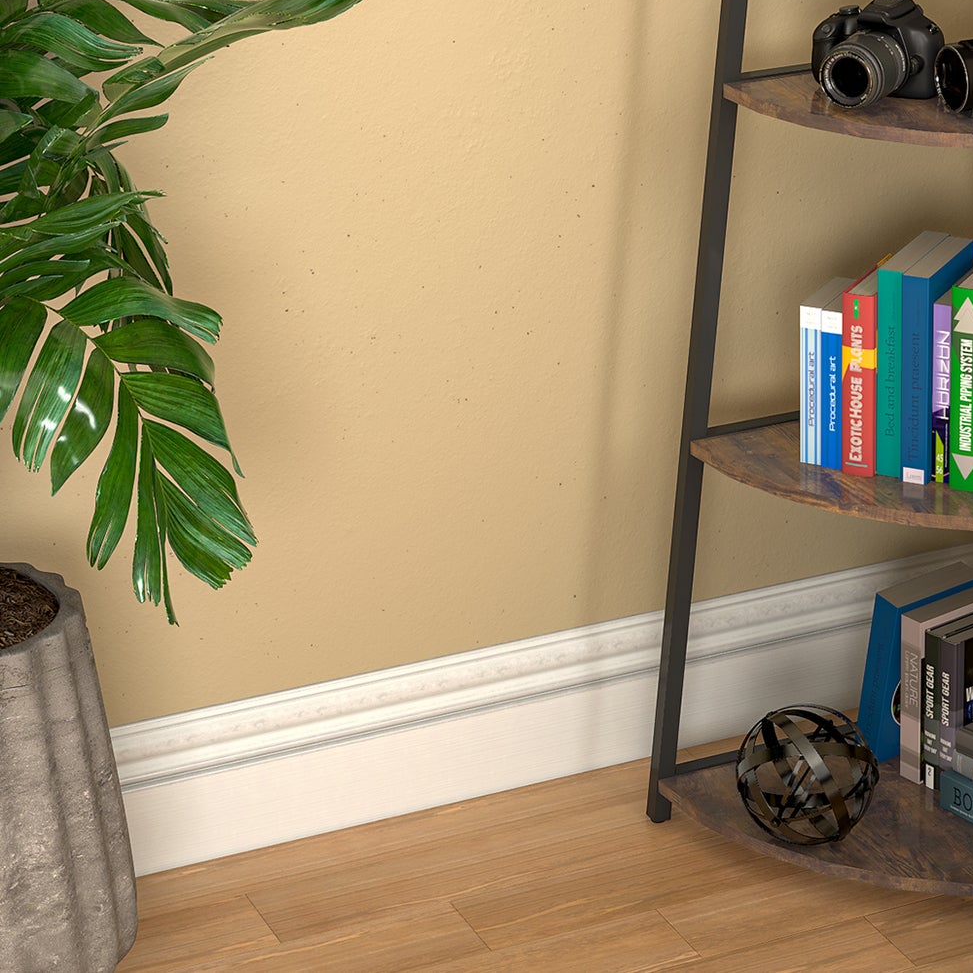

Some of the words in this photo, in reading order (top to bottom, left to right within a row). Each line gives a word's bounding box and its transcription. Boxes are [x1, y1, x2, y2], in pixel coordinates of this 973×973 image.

[829, 356, 837, 372] art
[886, 326, 896, 385] breakfast
[960, 339, 973, 372] SYSTEM
[935, 330, 950, 420] HORIZON
[960, 373, 973, 402] PIPING
[829, 374, 837, 432] Procedural
[849, 376, 863, 419] HOUSE
[885, 388, 895, 411] and
[849, 420, 863, 462] EXOTIC
[885, 414, 895, 437] Bed
[959, 402, 973, 451] INDUSTRIAL
[909, 652, 918, 708] NATURE
[926, 664, 935, 689] GEAR
[942, 672, 950, 697] GEAR
[925, 691, 934, 719] SPORT
[941, 698, 950, 727] SPORT
